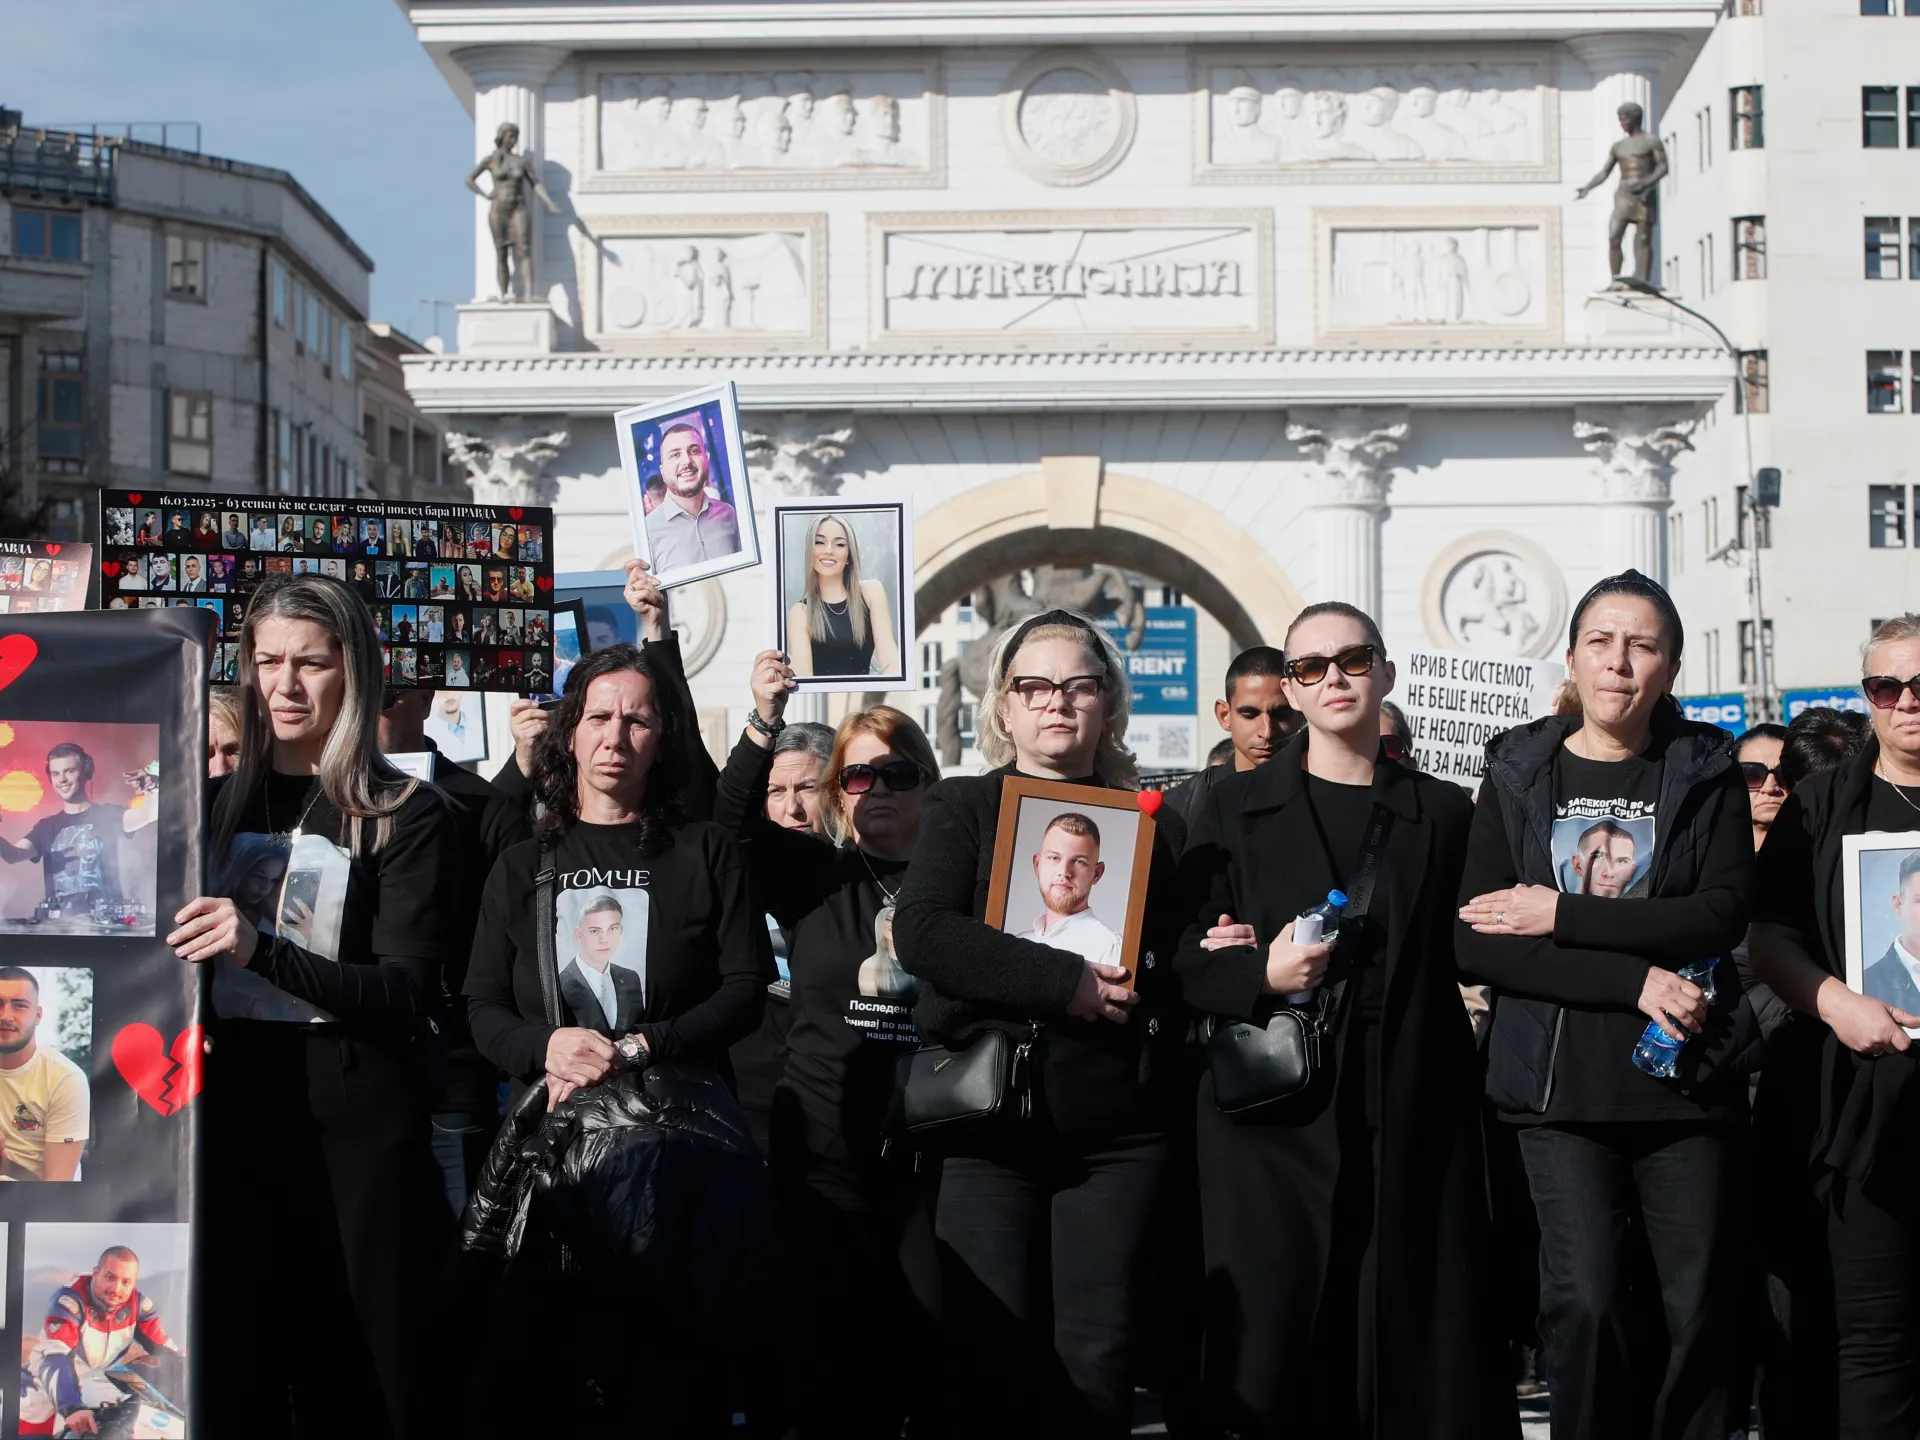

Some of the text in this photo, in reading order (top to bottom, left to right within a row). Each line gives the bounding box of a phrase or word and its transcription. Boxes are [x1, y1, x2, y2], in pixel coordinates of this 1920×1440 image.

[159, 495, 216, 508] 16.03.2025
[226, 498, 239, 510] 63
[241, 500, 276, 510] сенки
[278, 498, 292, 510] ќе
[294, 502, 306, 511] ве
[309, 502, 346, 513] следат
[356, 503, 385, 515] секој
[387, 506, 423, 517] поглед
[425, 505, 450, 518] бара
[452, 507, 497, 520] ПРАВДА
[1129, 657, 1186, 675] RENT
[1410, 653, 1534, 692] КРИВ Е СИСТЕМОТ,
[1408, 683, 1533, 720] НЕ БЕШЕ НЕСРЕЌА.
[1683, 704, 1742, 723] tec
[1432, 750, 1449, 774] ЗА
[1453, 753, 1484, 778] НАШ
[1567, 797, 1644, 809] ЗАСЕКОГАШ ВО
[1567, 806, 1642, 819] НАШИТЕ СРЦА
[559, 867, 650, 889] ТОМЧЕ
[849, 1000, 907, 1015] Последен
[882, 1021, 895, 1029] во
[866, 1031, 893, 1040] наше
